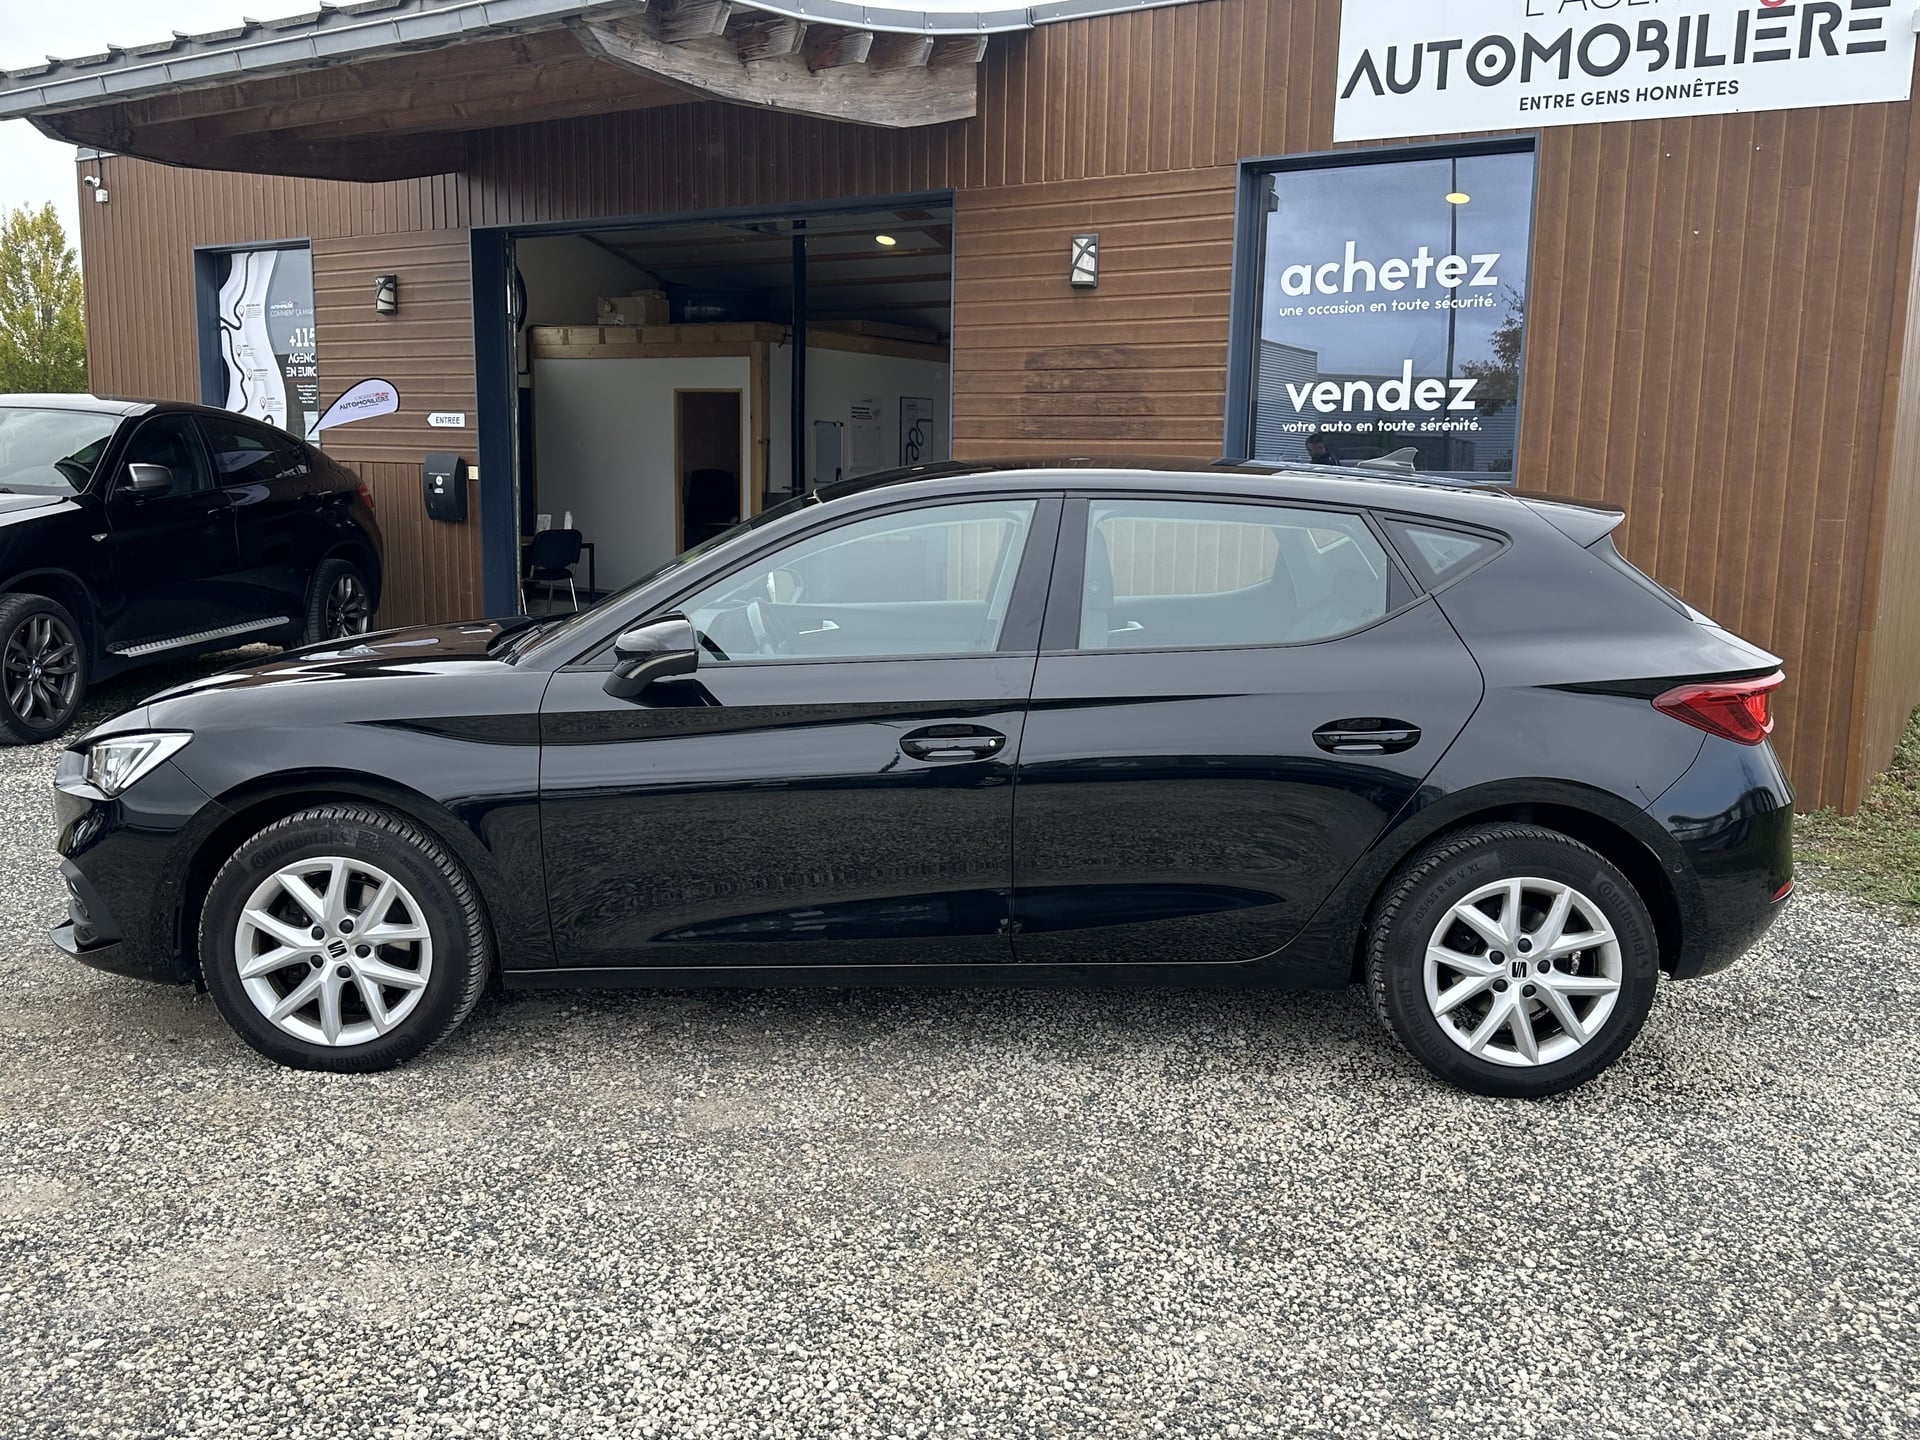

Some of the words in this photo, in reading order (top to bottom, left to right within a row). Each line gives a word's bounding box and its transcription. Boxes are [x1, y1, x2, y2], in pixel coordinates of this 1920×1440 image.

[1519, 95, 1576, 112] ENTRE
[1580, 88, 1631, 107] GENS
[1635, 79, 1740, 103] HONNÊTES
[1280, 240, 1500, 296] achetez
[1279, 304, 1304, 317] une
[1308, 300, 1365, 315] occasion
[1370, 301, 1387, 313] en
[1391, 297, 1431, 312] toute
[1434, 292, 1498, 310] sécurité.
[286, 366, 297, 377] EN
[1285, 359, 1478, 413] vendez
[1282, 421, 1316, 433] votre
[1320, 421, 1352, 433] auto
[1356, 421, 1373, 432] en
[1377, 419, 1416, 432] toute
[1420, 416, 1482, 432] sérénité.
